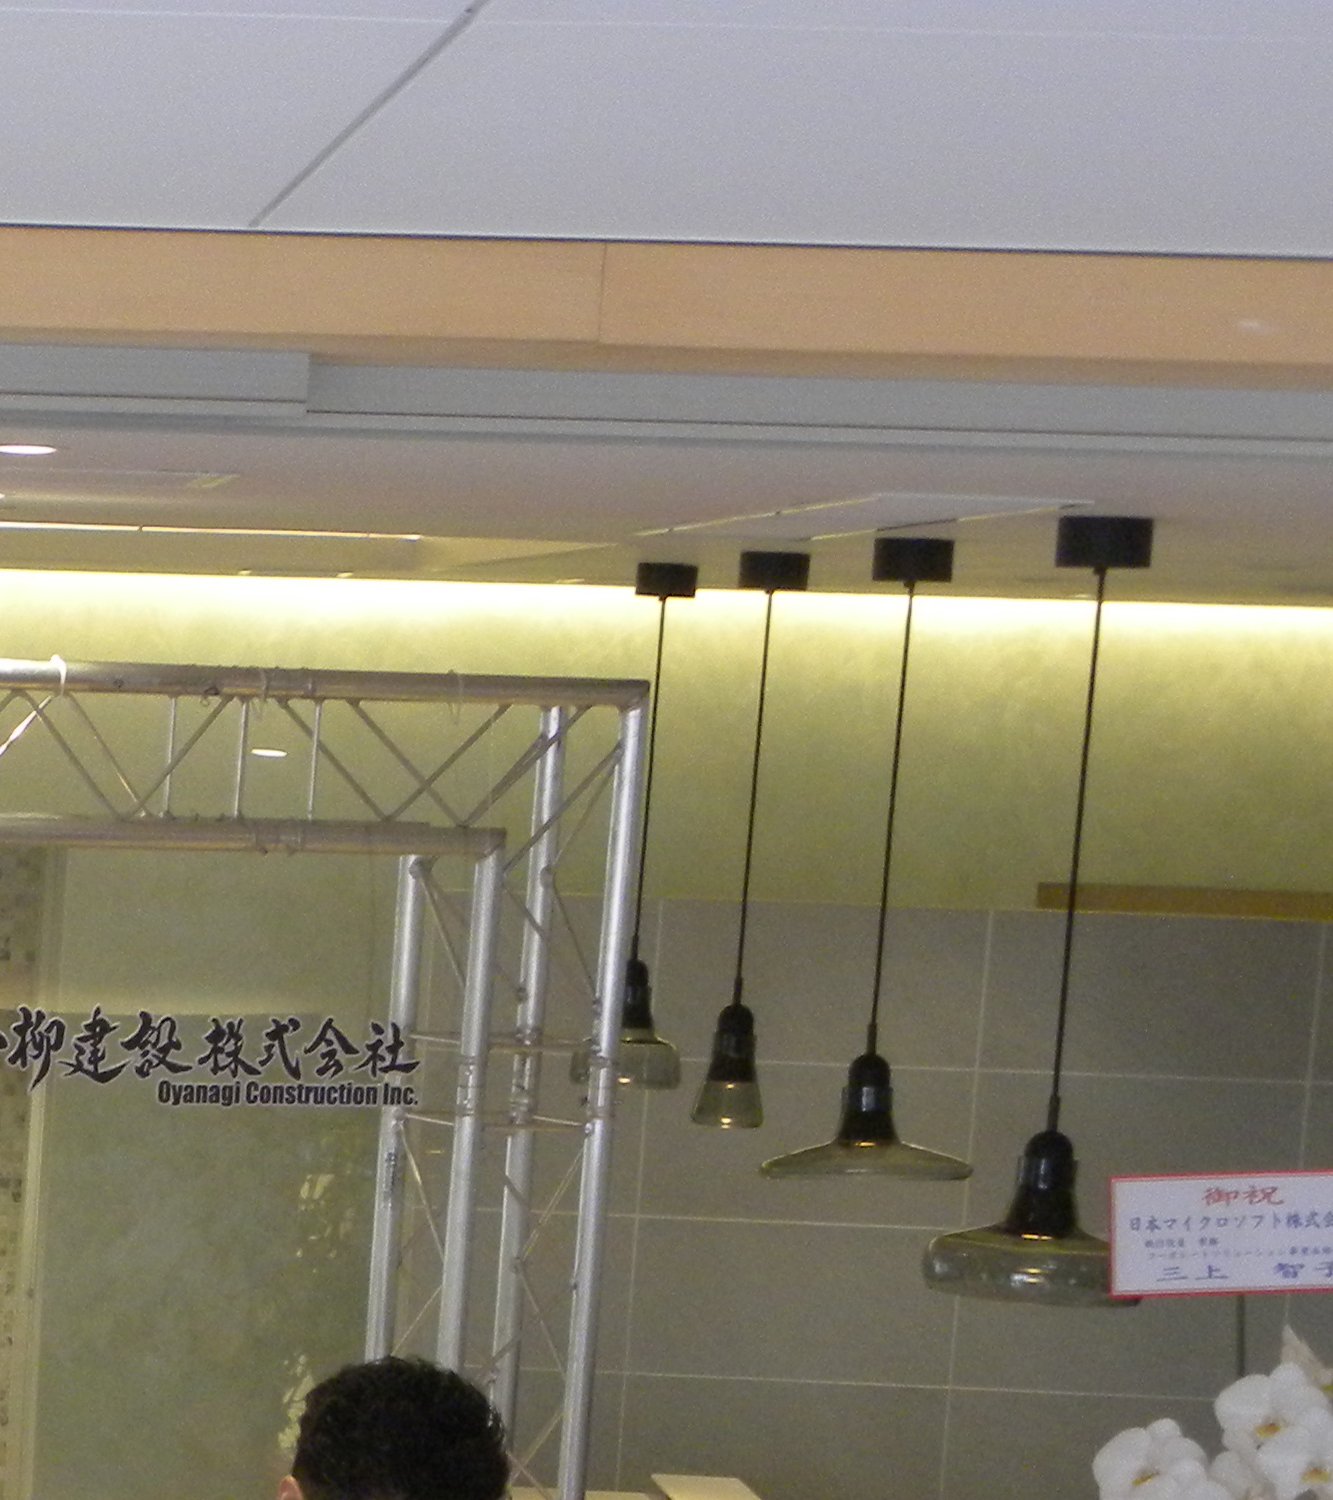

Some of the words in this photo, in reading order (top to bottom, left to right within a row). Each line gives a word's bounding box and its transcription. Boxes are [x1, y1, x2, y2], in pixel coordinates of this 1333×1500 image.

[158, 1080, 240, 1107] Oyanagi
[246, 1081, 378, 1106] Construction
[383, 1082, 419, 1106] Inc.
[1202, 1185, 1285, 1207] 御祝
